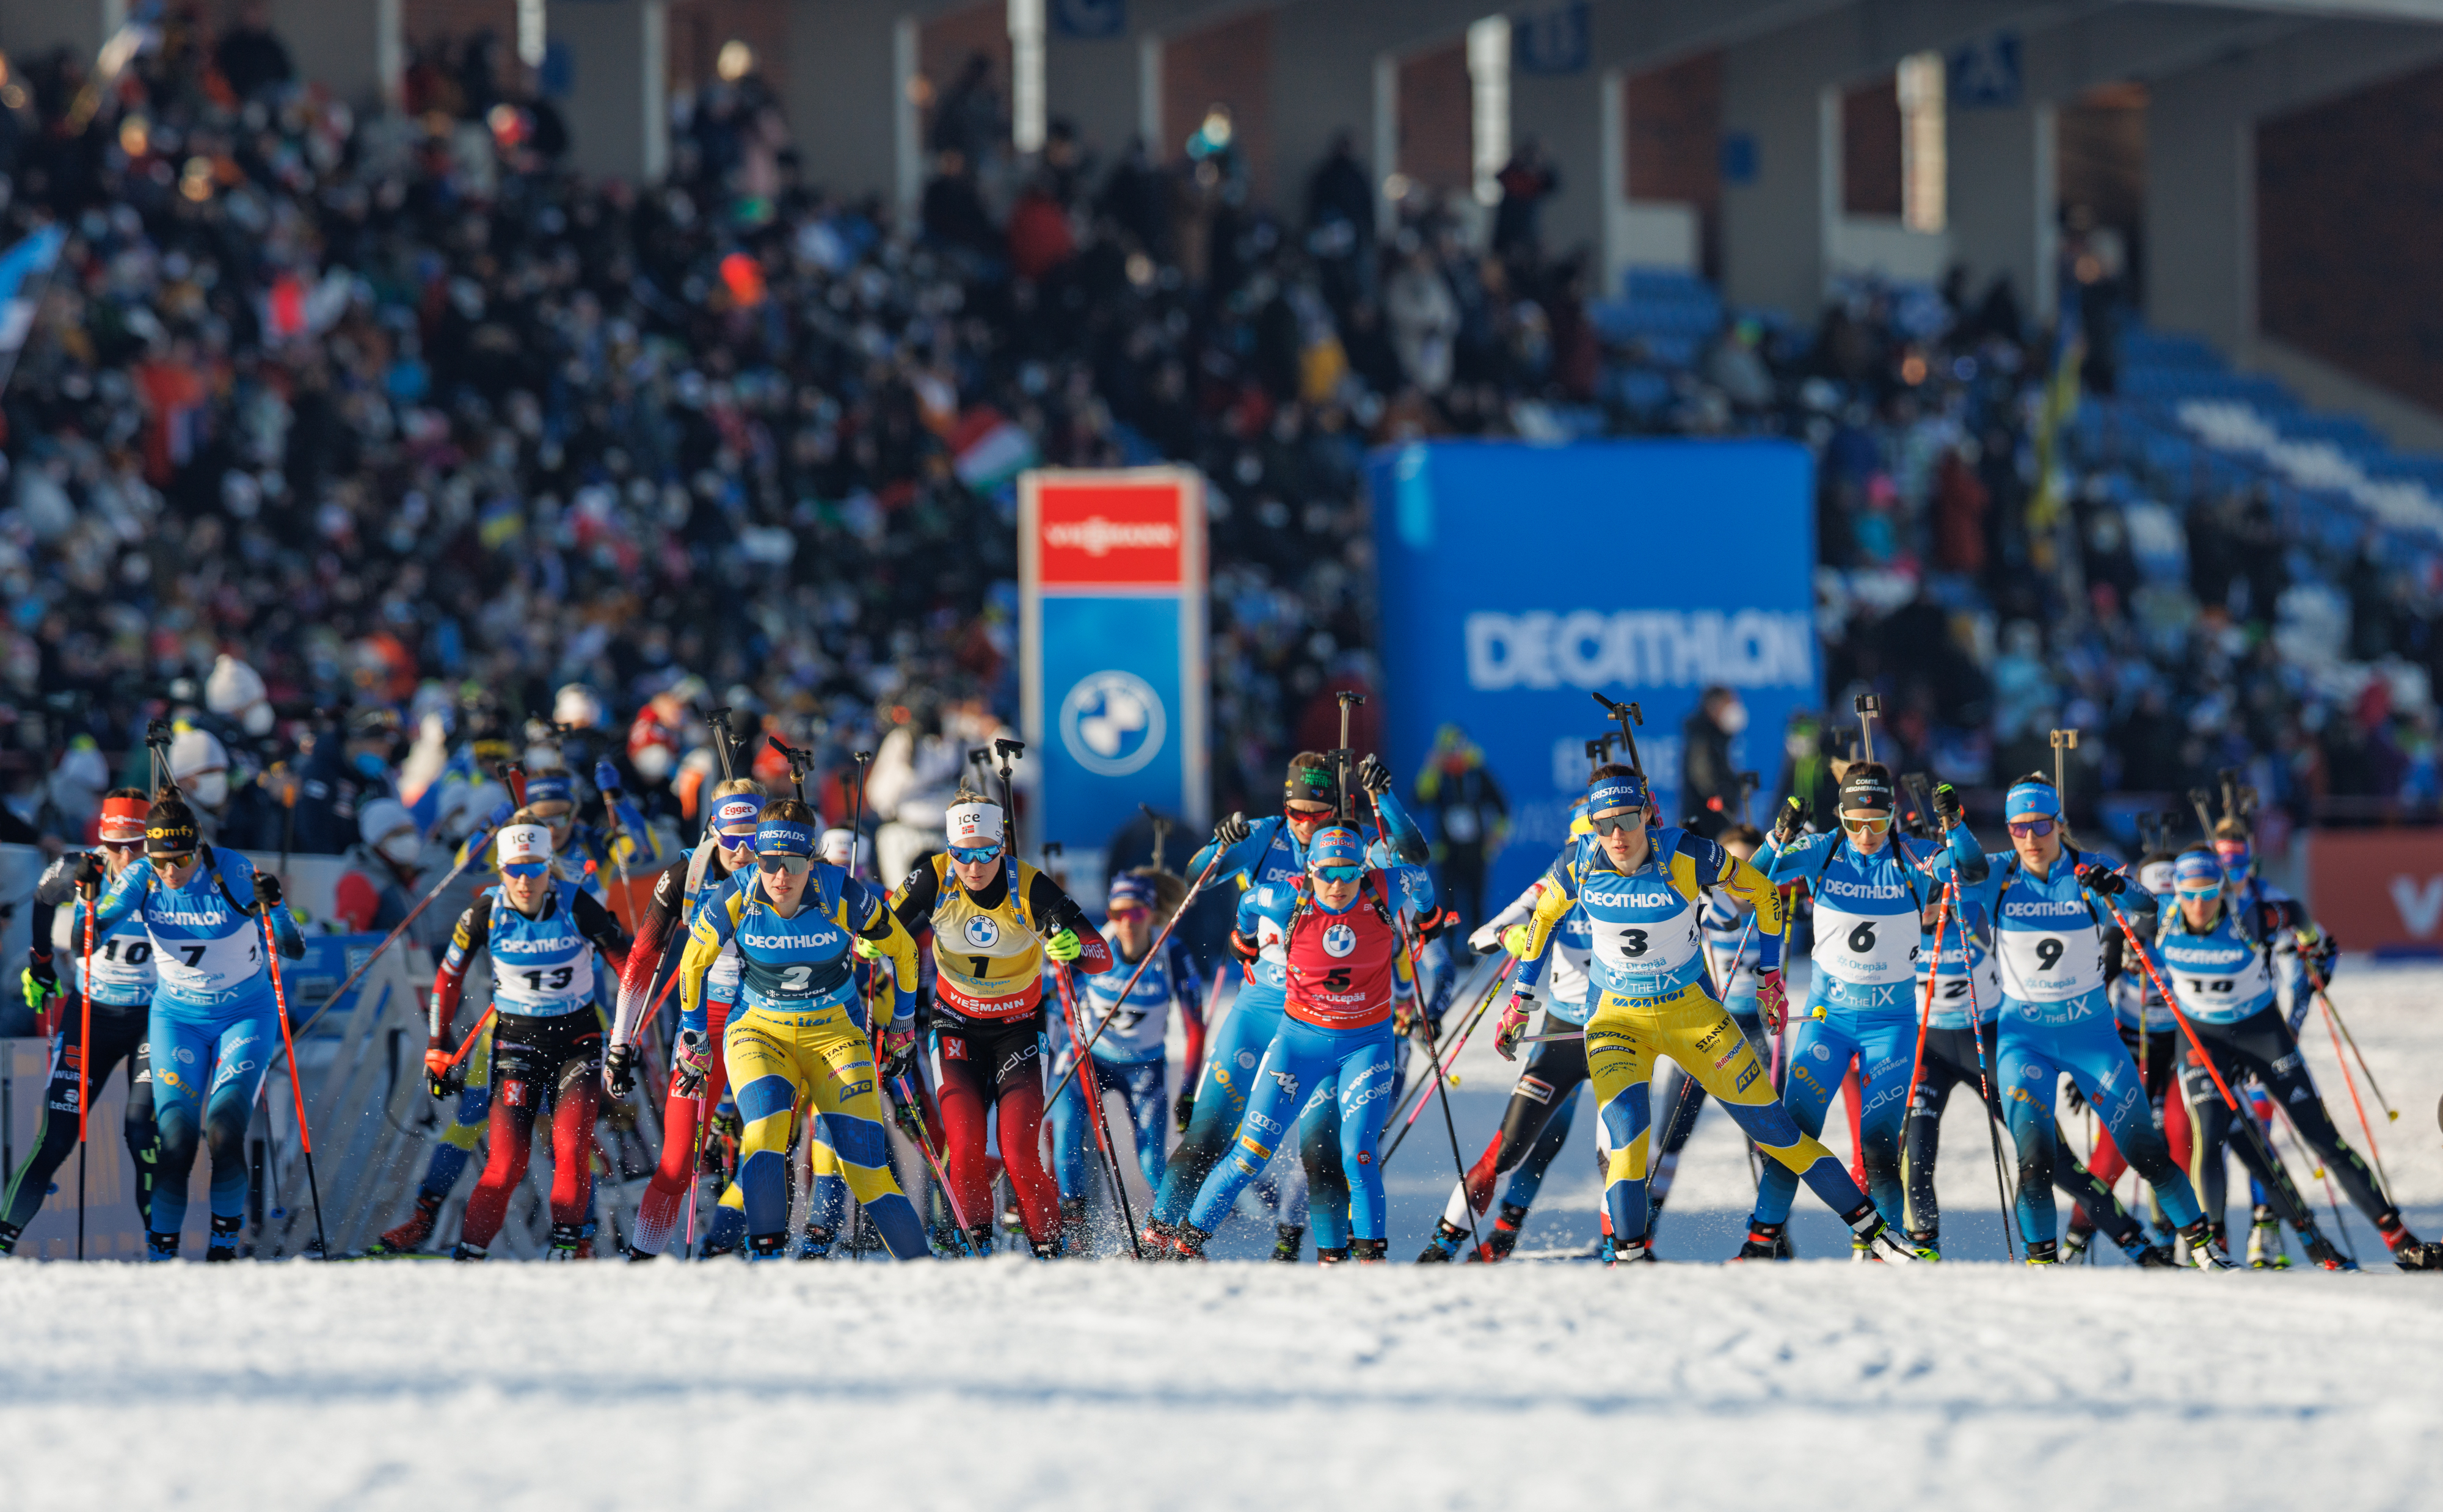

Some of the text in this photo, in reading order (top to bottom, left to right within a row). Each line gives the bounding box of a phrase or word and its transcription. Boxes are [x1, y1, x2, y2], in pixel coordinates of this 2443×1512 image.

[1468, 609, 1815, 691] DECATHLON
[1305, 773, 1329, 784] MARCEL
[1305, 779, 1329, 788] PETITE
[1590, 786, 1634, 802] FRISTADS
[724, 805, 753, 816] Egger
[958, 813, 981, 826] ice
[146, 824, 194, 840] somfy
[759, 830, 806, 841] FRISTADS
[1319, 839, 1356, 850] Red Bull
[1650, 837, 1660, 852] ATG
[1658, 861, 1669, 875] ATG
[812, 877, 821, 893] ATG
[1824, 878, 1906, 900] DECATHLON
[743, 890, 752, 907] ATG
[819, 901, 830, 915] ATG
[1584, 889, 1674, 908] DECATHLON
[1769, 887, 1782, 921] SWE
[148, 909, 228, 926] DECATHLON
[2004, 900, 2089, 917] DECATHLON
[969, 916, 995, 928] BMW
[745, 931, 838, 950] DECATHLON
[1526, 920, 1538, 949] OPTIMERA
[1619, 928, 1648, 958] 3
[1848, 921, 1877, 953] 6
[2120, 923, 2146, 959] WAY
[104, 939, 152, 965] 10
[500, 936, 581, 954] DECATHLON
[2036, 938, 2064, 971] 9
[2164, 945, 2244, 964] DECATHLON
[180, 945, 207, 967] 7
[967, 956, 990, 979] 1
[1849, 961, 1888, 973] Otepää
[521, 966, 573, 992] 13
[781, 966, 813, 991] 2
[1322, 967, 1352, 994] 5
[1630, 983, 1654, 993] THE
[2039, 976, 2077, 990] Otepää
[949, 990, 1025, 1012] VIESSMANN
[1848, 985, 1896, 1007] THE iX
[941, 1003, 963, 1023] LAPUA
[2044, 1014, 2067, 1024] THE
[1071, 999, 1088, 1049] SWIX
[1695, 1014, 1731, 1050] STANLEY
[737, 1038, 780, 1053] OPTIMERA
[1586, 1031, 1637, 1044] FRISTADS
[1702, 1038, 1720, 1054] Security
[821, 1039, 867, 1063] STANLEY
[823, 1052, 843, 1066] Security
[1590, 1046, 1630, 1057] OPTIMERA
[828, 1059, 872, 1081] Autoexperten
[996, 1044, 1038, 1084] odlo
[1594, 1061, 1637, 1077] SWEDEMOUNT
[54, 1069, 93, 1087] WÜRH
[1212, 1060, 1245, 1112] somfy
[1348, 1060, 1391, 1093] sportful
[1738, 1063, 1760, 1090] ATG
[1789, 1061, 1828, 1104] somfy
[156, 1067, 201, 1107] somfy
[840, 1082, 872, 1099] ATG
[1862, 1085, 1905, 1118] odlo
[2005, 1085, 2052, 1119] somfy
[2109, 1086, 2137, 1133] odlo
[1247, 1123, 1261, 1133] Audi
